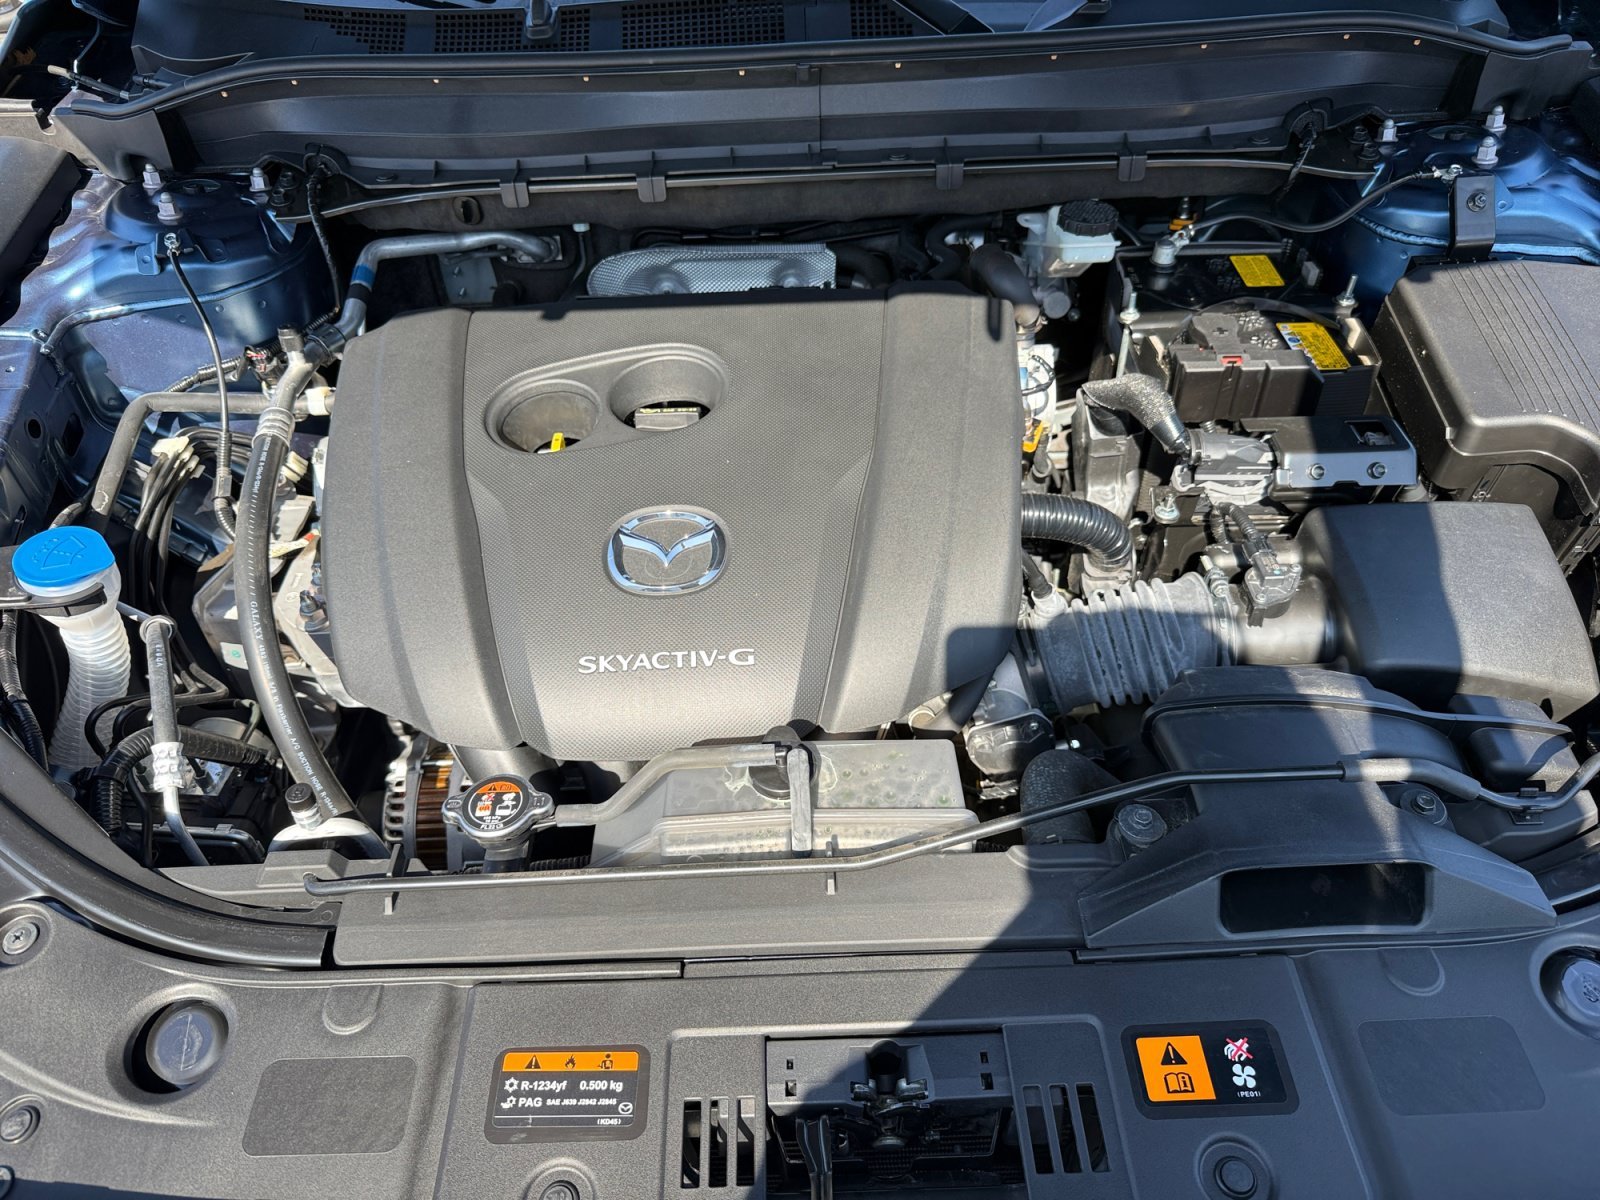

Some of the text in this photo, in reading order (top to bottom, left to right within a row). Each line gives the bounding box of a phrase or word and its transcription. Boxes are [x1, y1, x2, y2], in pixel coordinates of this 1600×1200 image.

[578, 648, 755, 674] SKYACTIV-G
[250, 601, 264, 641] GALAXY
[297, 751, 314, 776] SUCTION
[310, 775, 323, 792] HOSE
[520, 1080, 624, 1092] R-1234yf 0.500 kg
[518, 1097, 542, 1107] PAG
